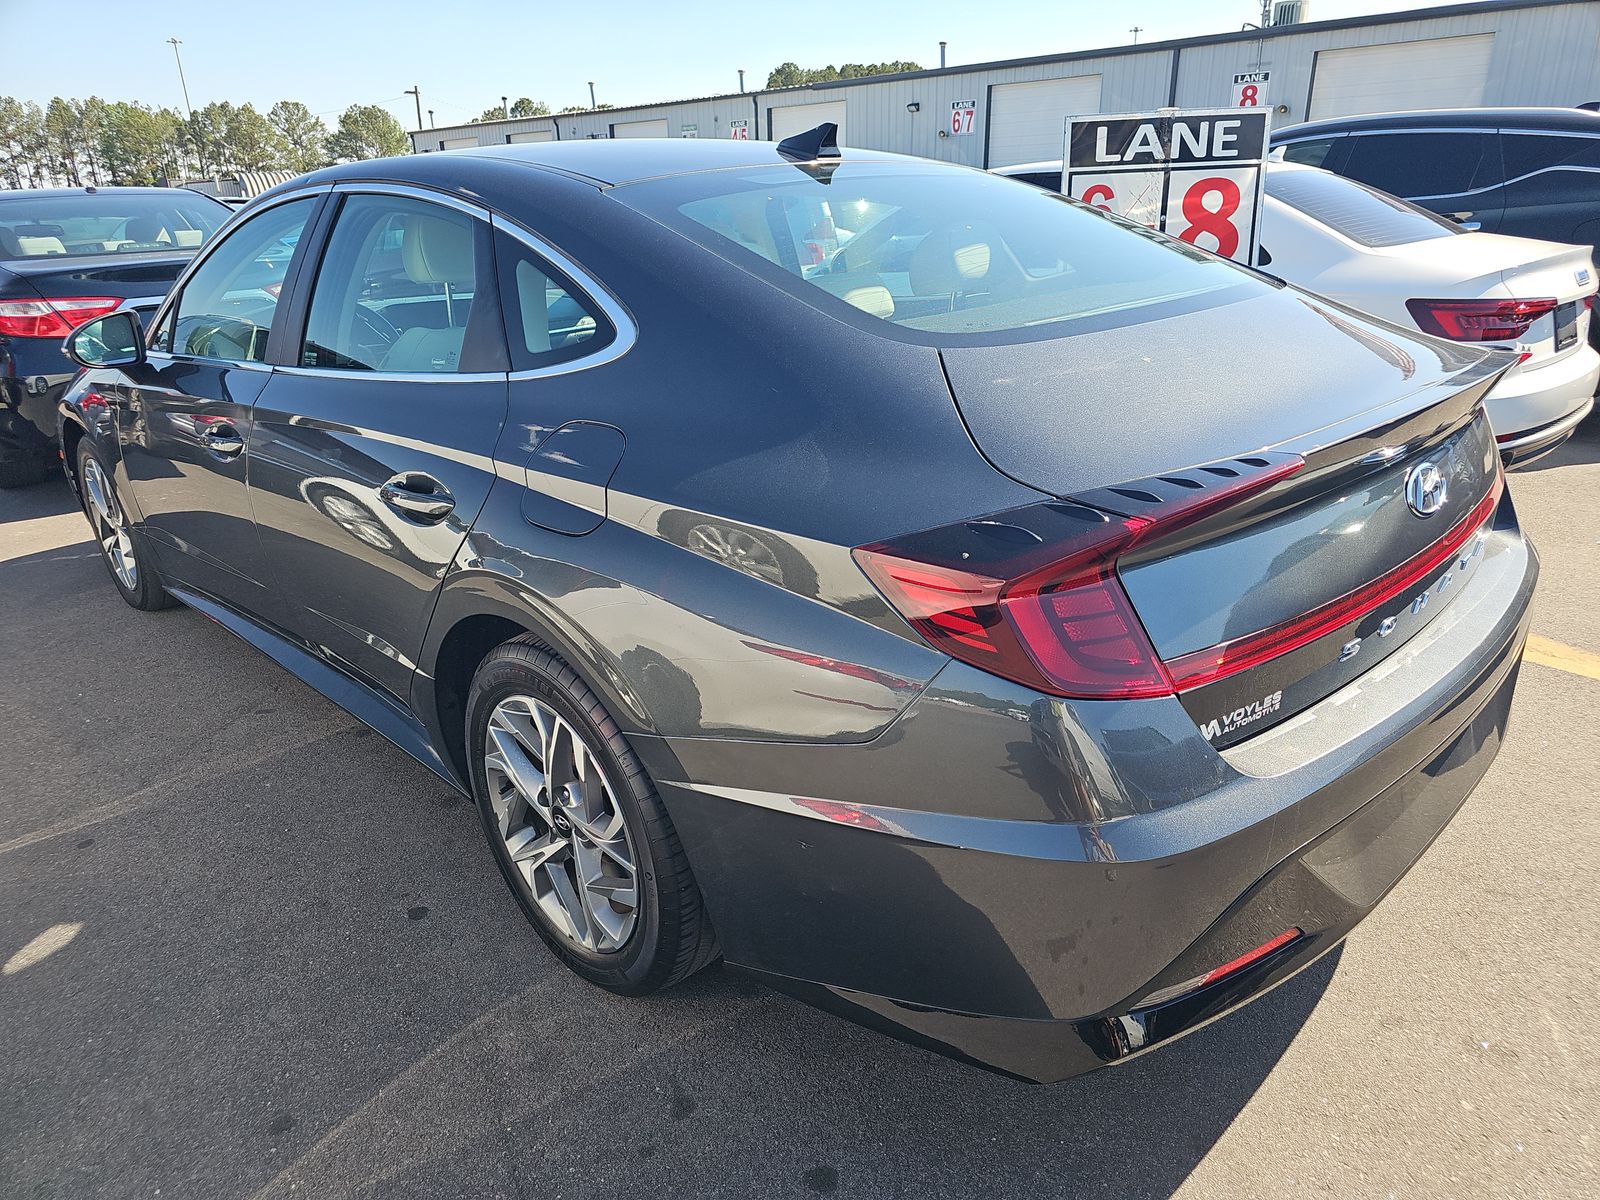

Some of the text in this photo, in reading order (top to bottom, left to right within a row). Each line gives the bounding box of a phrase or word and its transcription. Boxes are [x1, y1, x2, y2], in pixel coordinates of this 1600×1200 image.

[1238, 74, 1265, 83] LANE
[1240, 85, 1258, 107] 8
[952, 110, 974, 133] 6/7
[1095, 120, 1241, 162] LANE
[1179, 177, 1241, 259] 8
[1222, 690, 1283, 726] VOYLES
[1222, 701, 1281, 735] AUTOMOTIVE
